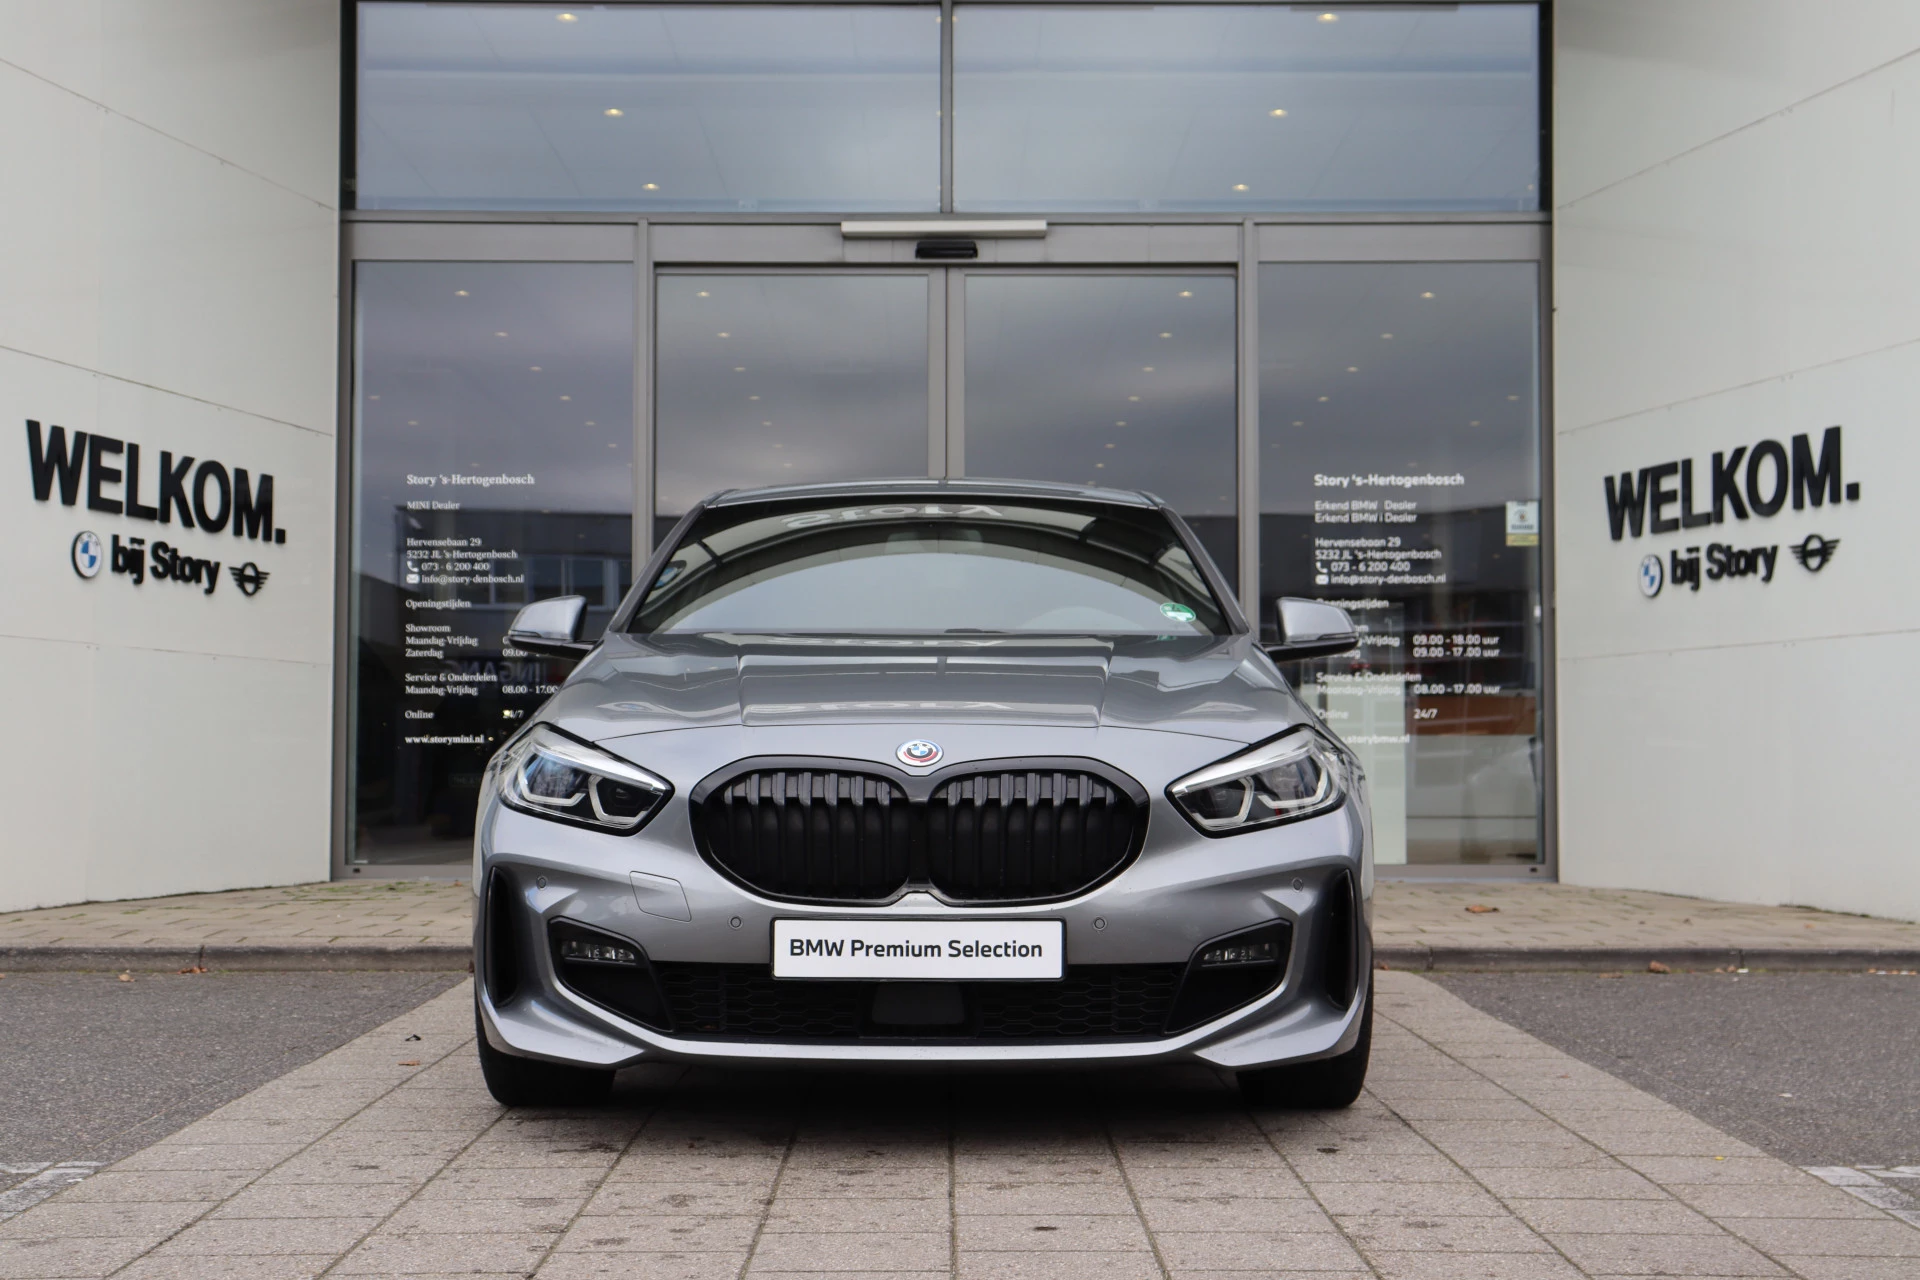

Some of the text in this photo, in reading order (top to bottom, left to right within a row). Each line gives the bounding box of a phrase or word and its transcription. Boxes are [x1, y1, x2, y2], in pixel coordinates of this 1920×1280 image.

[26, 419, 286, 544] WELKOM.
[406, 474, 535, 487] Story 's-Hertogenbosch
[1314, 473, 1465, 488] Story 's-Hertogenbosch
[1604, 425, 1860, 541] WELKOM.
[406, 501, 460, 510] MINI Dealer
[1315, 501, 1417, 511] Erkend BMW Dealer
[1315, 513, 1349, 523] Erkend
[1351, 513, 1378, 523] BMW
[1384, 513, 1417, 523] Dealer
[406, 538, 482, 547] Hervensebaan 29
[1315, 538, 1401, 548] Hervensebaan 29
[406, 550, 518, 560] 5232 JL 's-Hertogenbosch
[1315, 550, 1442, 560] 5232 JL 's-Hertogenbosch
[111, 534, 220, 595] bij Story
[421, 562, 438, 571] 073
[446, 562, 451, 571] 6
[454, 562, 471, 571] 200
[472, 562, 490, 571] 400
[1331, 562, 1350, 572] 073
[1358, 562, 1365, 572] 6
[1367, 562, 1388, 572] 200
[1389, 562, 1411, 572] 400
[1671, 543, 1778, 591] bij Story
[421, 574, 525, 585] info@story-denbosch.nl
[1331, 574, 1446, 585] info@story-denbosch.nl
[405, 599, 472, 610] Openingstijden
[1316, 598, 1389, 610] eningstijden
[405, 624, 450, 633] Showroom
[405, 636, 478, 647] Maandag-Vrijdag
[1413, 634, 1444, 645] 09.00
[1482, 636, 1500, 645] uur
[405, 649, 444, 659] Zaterdag
[1413, 646, 1444, 657] 09.00
[1482, 648, 1500, 657] uur
[405, 673, 497, 682] Service & Onderdelen
[1316, 672, 1353, 683] Service
[1364, 671, 1422, 682] Onderdelen
[405, 685, 478, 696] Maandag-Vrijdag
[502, 685, 527, 694] 08.00
[1413, 683, 1445, 694] 08.00
[1483, 685, 1501, 694] uur
[405, 711, 434, 719] Online
[1414, 708, 1438, 719] 24/7
[405, 735, 485, 745] www.storymini.nl
[789, 938, 1043, 958] BMW Premium Selection
